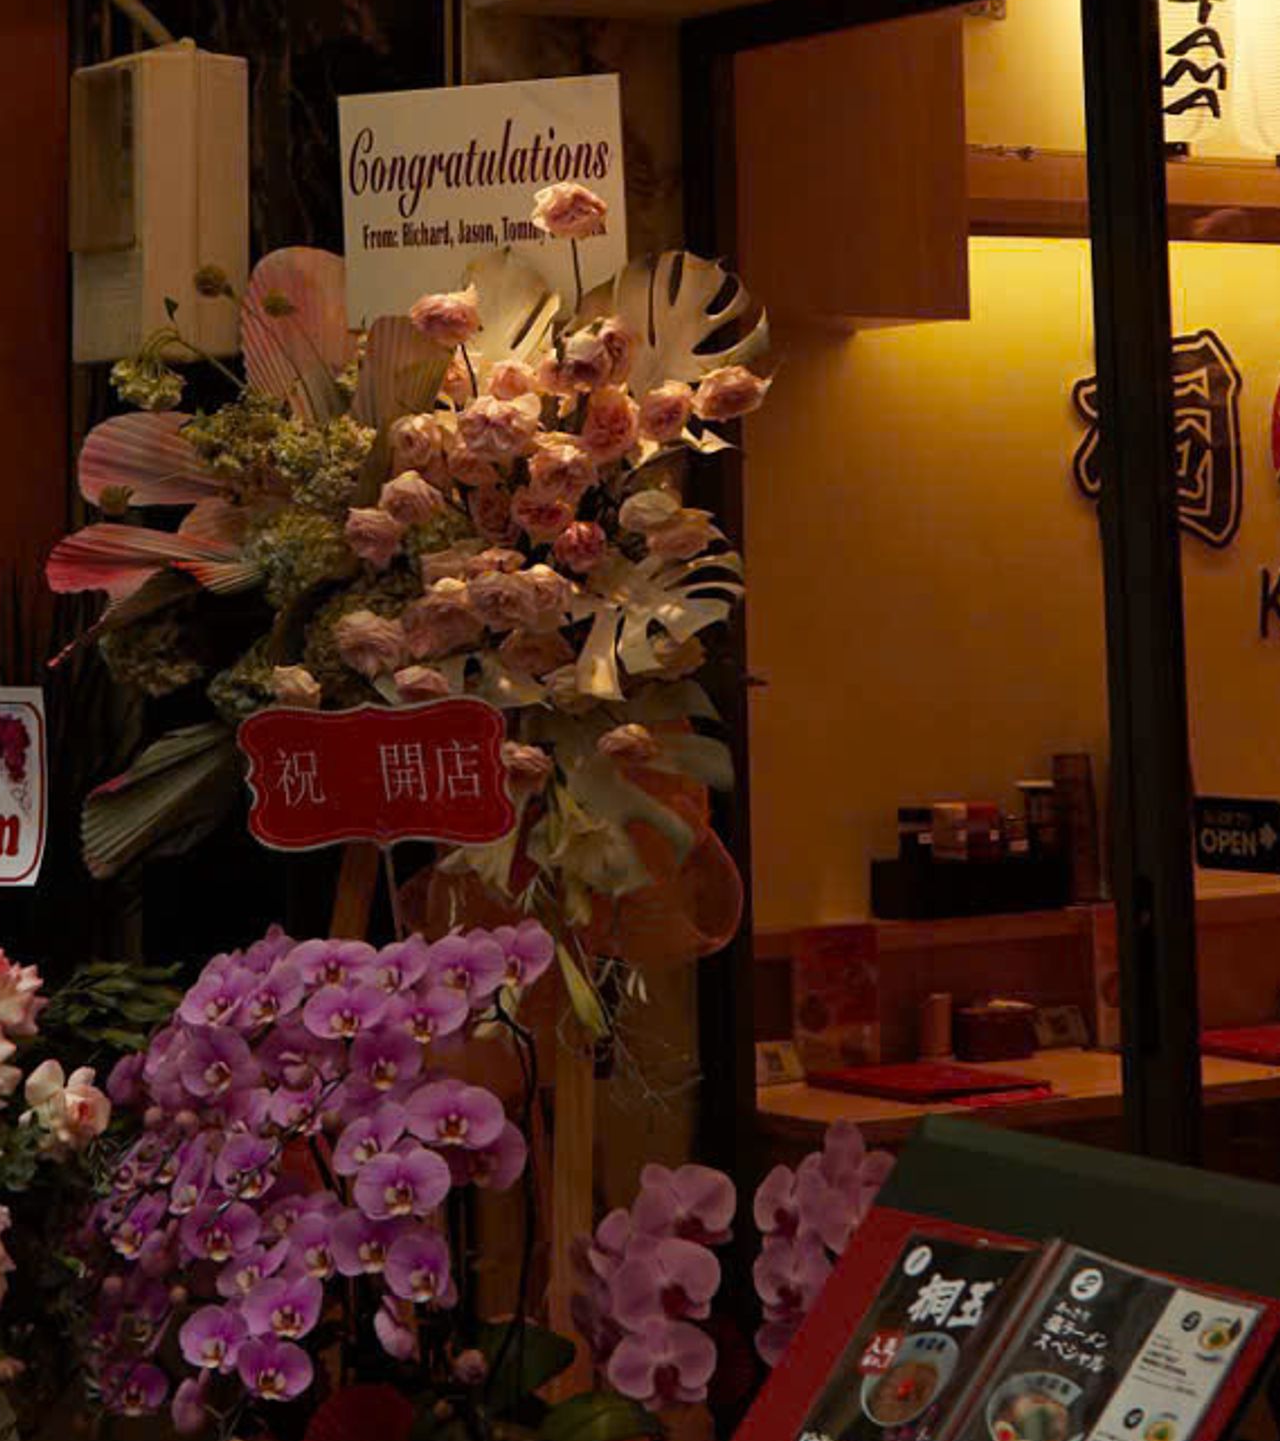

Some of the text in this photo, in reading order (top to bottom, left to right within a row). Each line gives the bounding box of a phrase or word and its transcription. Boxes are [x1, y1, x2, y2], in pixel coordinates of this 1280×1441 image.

[349, 117, 610, 219] Congratulations
[403, 220, 455, 249] Richard,
[458, 216, 499, 247] Jason,
[272, 738, 480, 807] 祝 開店
[1200, 826, 1258, 859] OPEN
